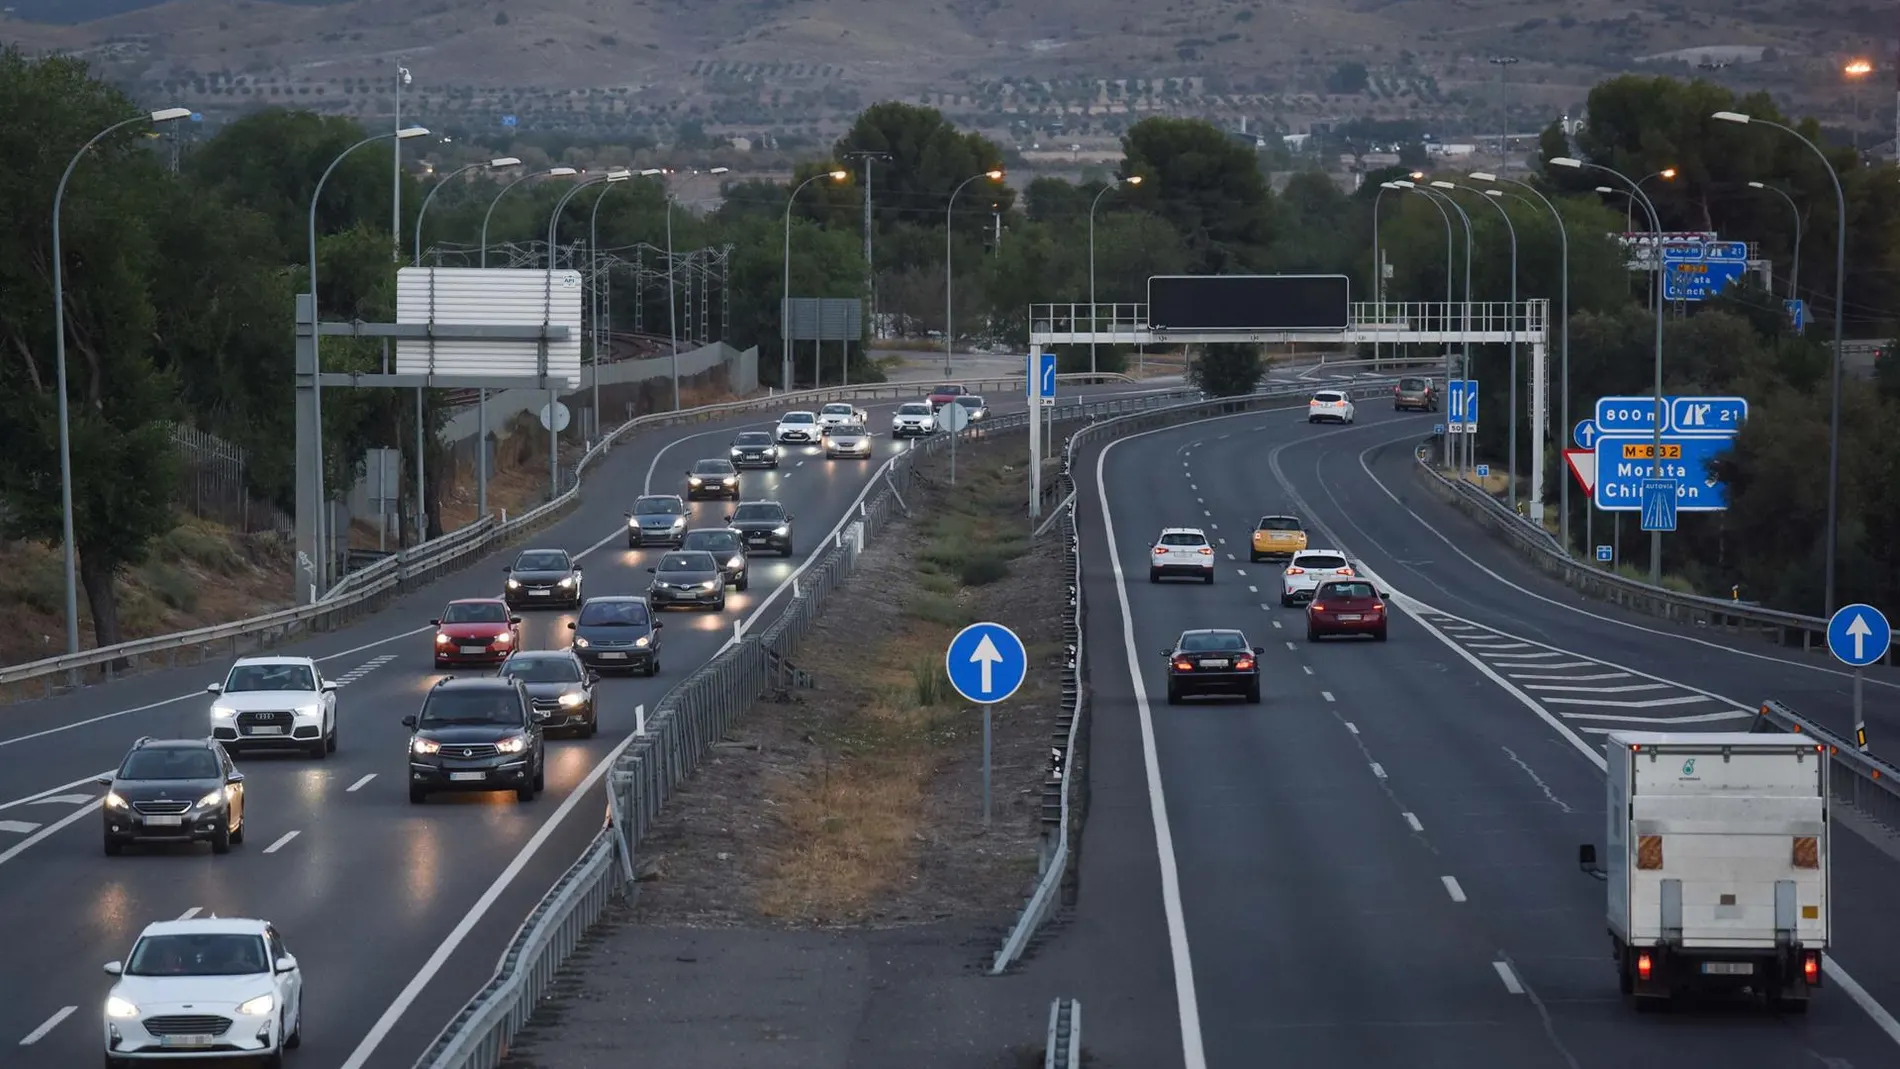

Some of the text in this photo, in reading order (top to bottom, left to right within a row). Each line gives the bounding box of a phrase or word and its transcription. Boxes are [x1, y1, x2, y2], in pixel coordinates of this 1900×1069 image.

[1606, 409, 1641, 421] 800
[1720, 409, 1738, 421] 21
[1625, 446, 1679, 457] M-832
